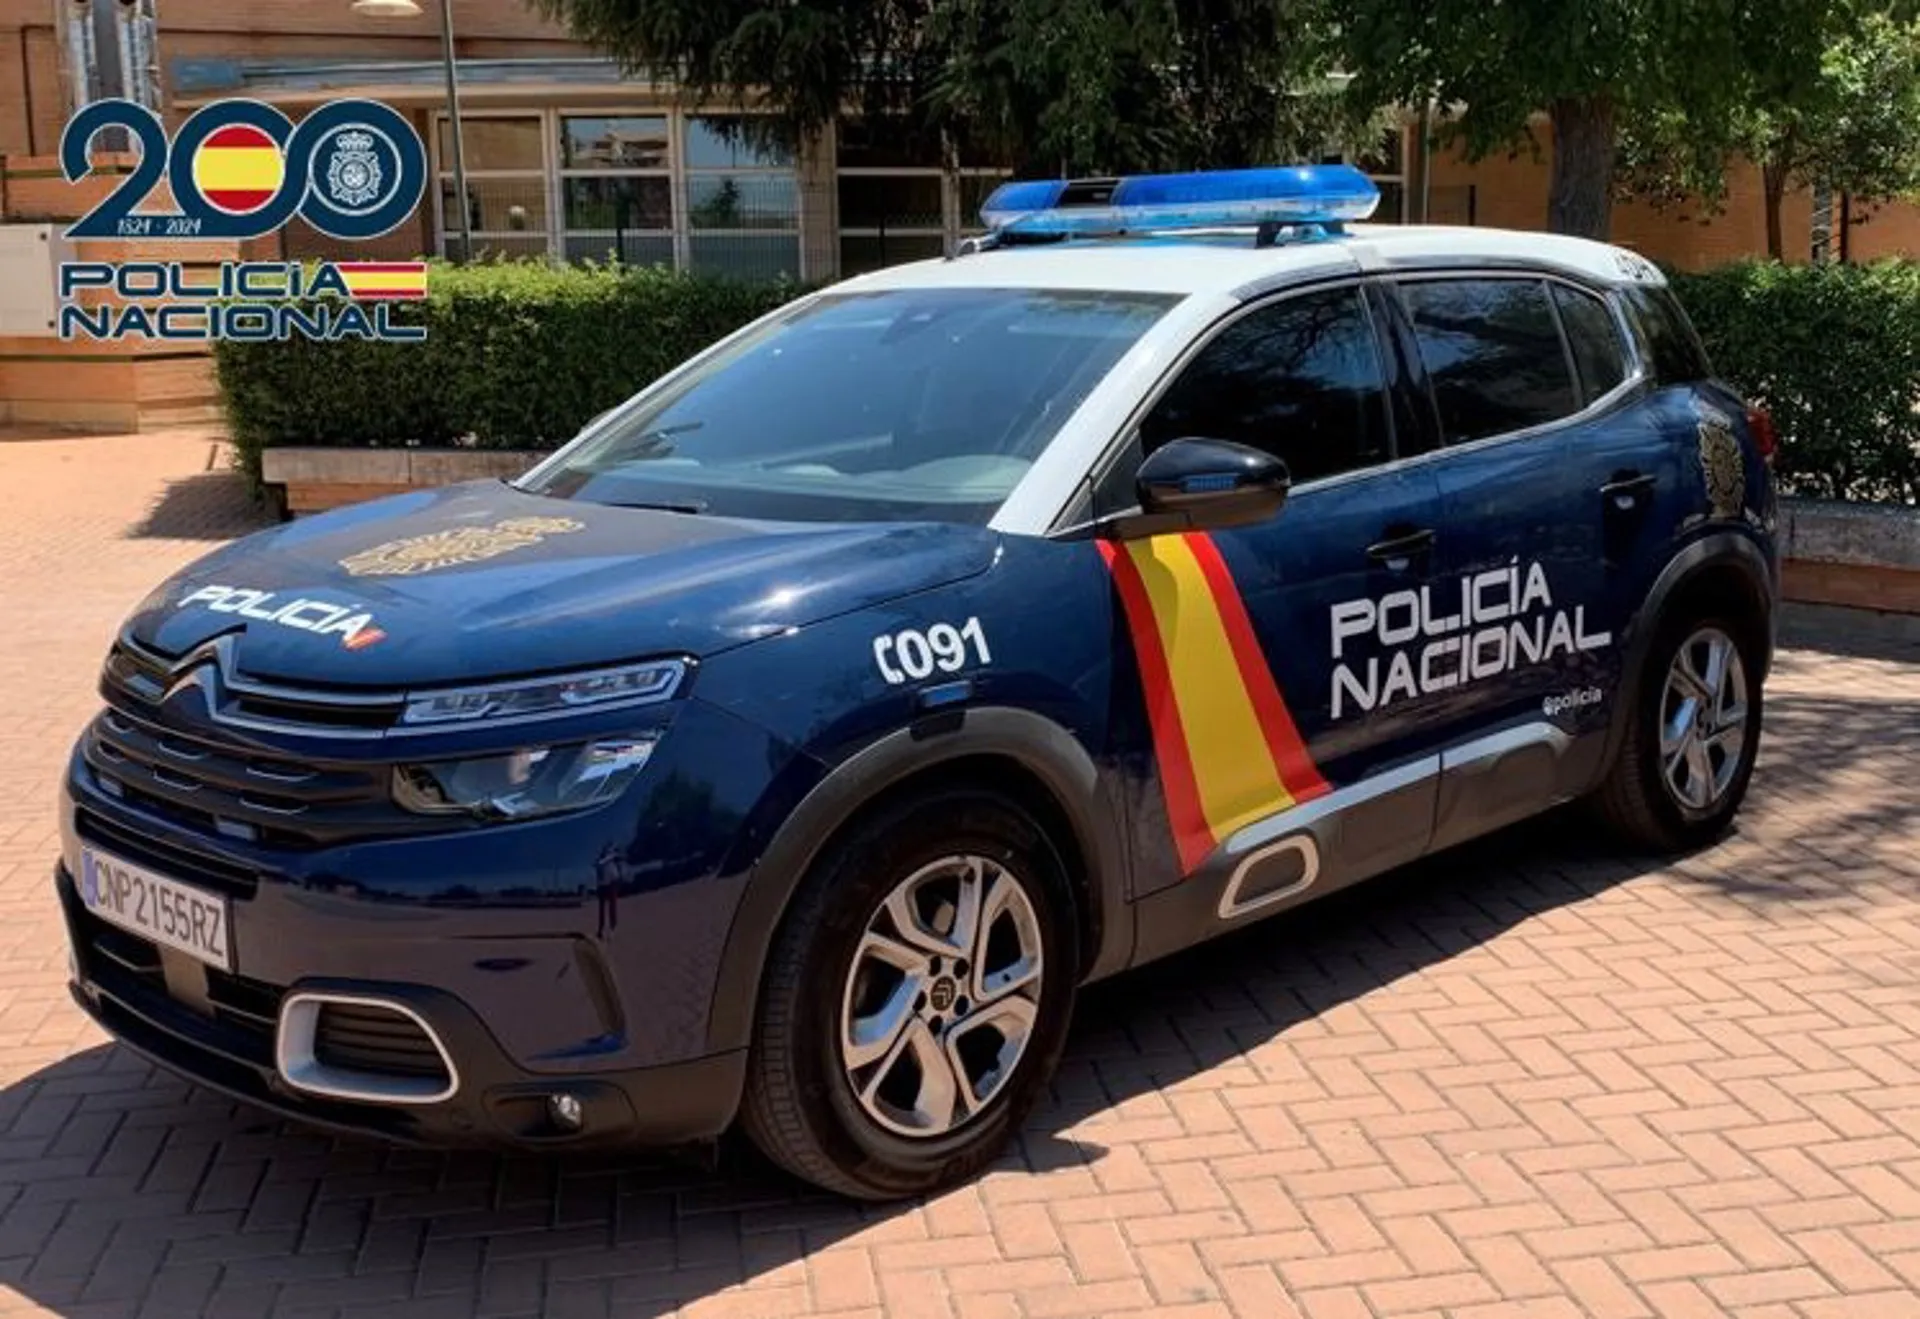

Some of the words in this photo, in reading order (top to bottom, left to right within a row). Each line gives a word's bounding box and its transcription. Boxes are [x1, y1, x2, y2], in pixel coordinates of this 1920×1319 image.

[1331, 556, 1552, 659] POLICÍA
[1330, 605, 1612, 720] NACIONAL
[94, 861, 223, 957] CNP2155RZ
